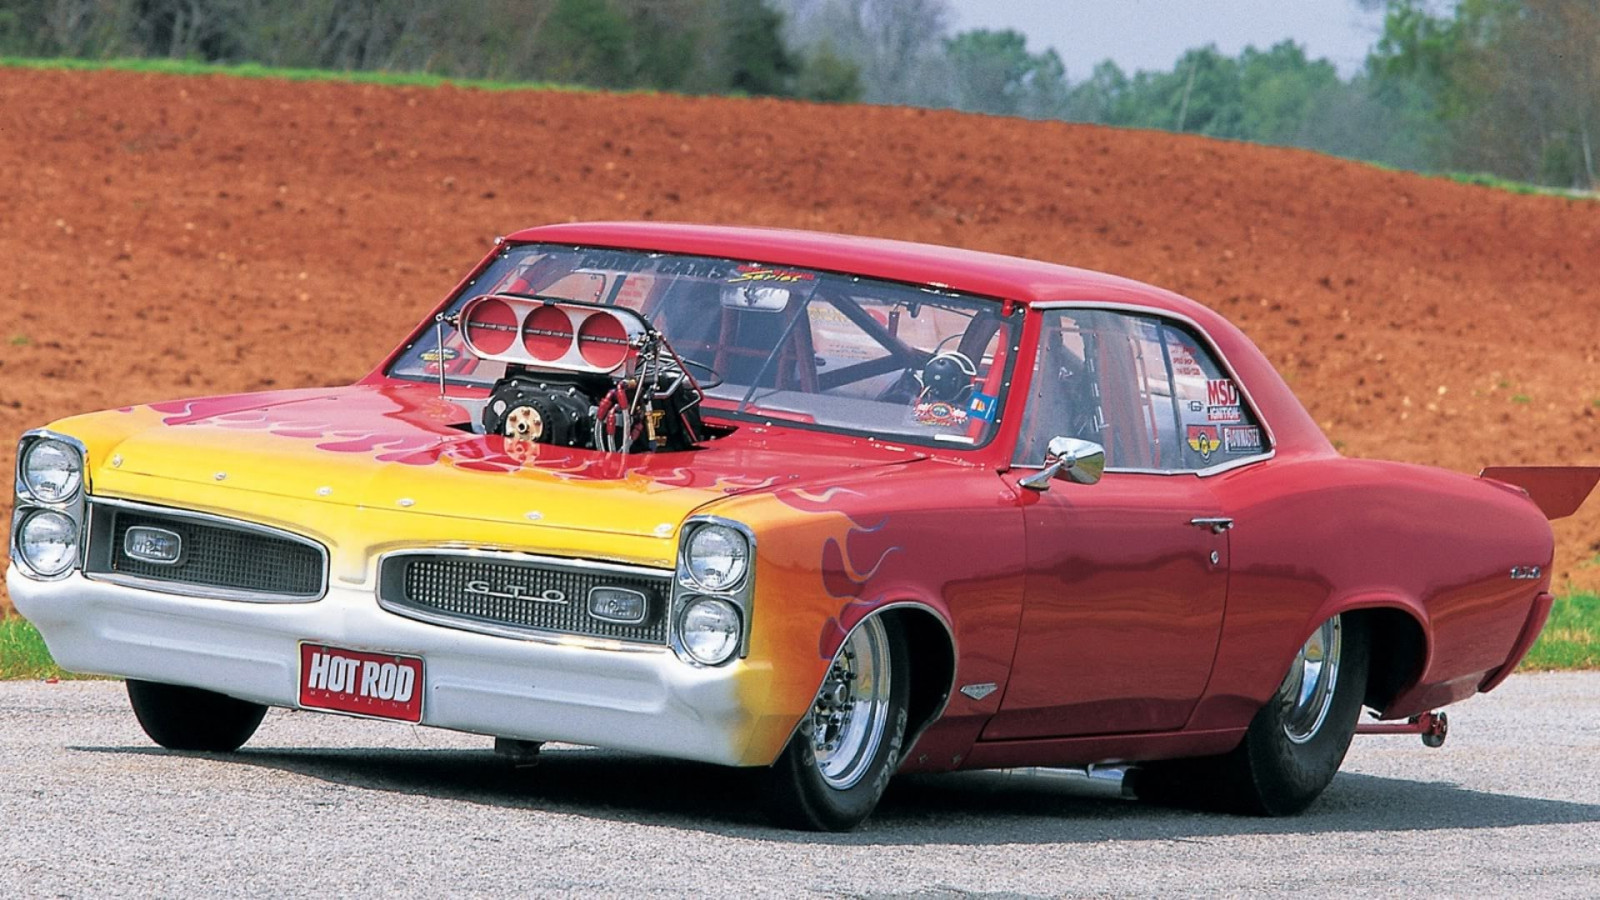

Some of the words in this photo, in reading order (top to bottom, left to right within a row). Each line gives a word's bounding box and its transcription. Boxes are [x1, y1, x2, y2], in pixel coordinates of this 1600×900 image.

[1207, 380, 1238, 405] MSD
[1209, 406, 1240, 420] IGNITION
[464, 580, 568, 604] GTO
[308, 652, 361, 694] HOT
[360, 660, 415, 702] ROD
[310, 690, 411, 710] MAGAZINE
